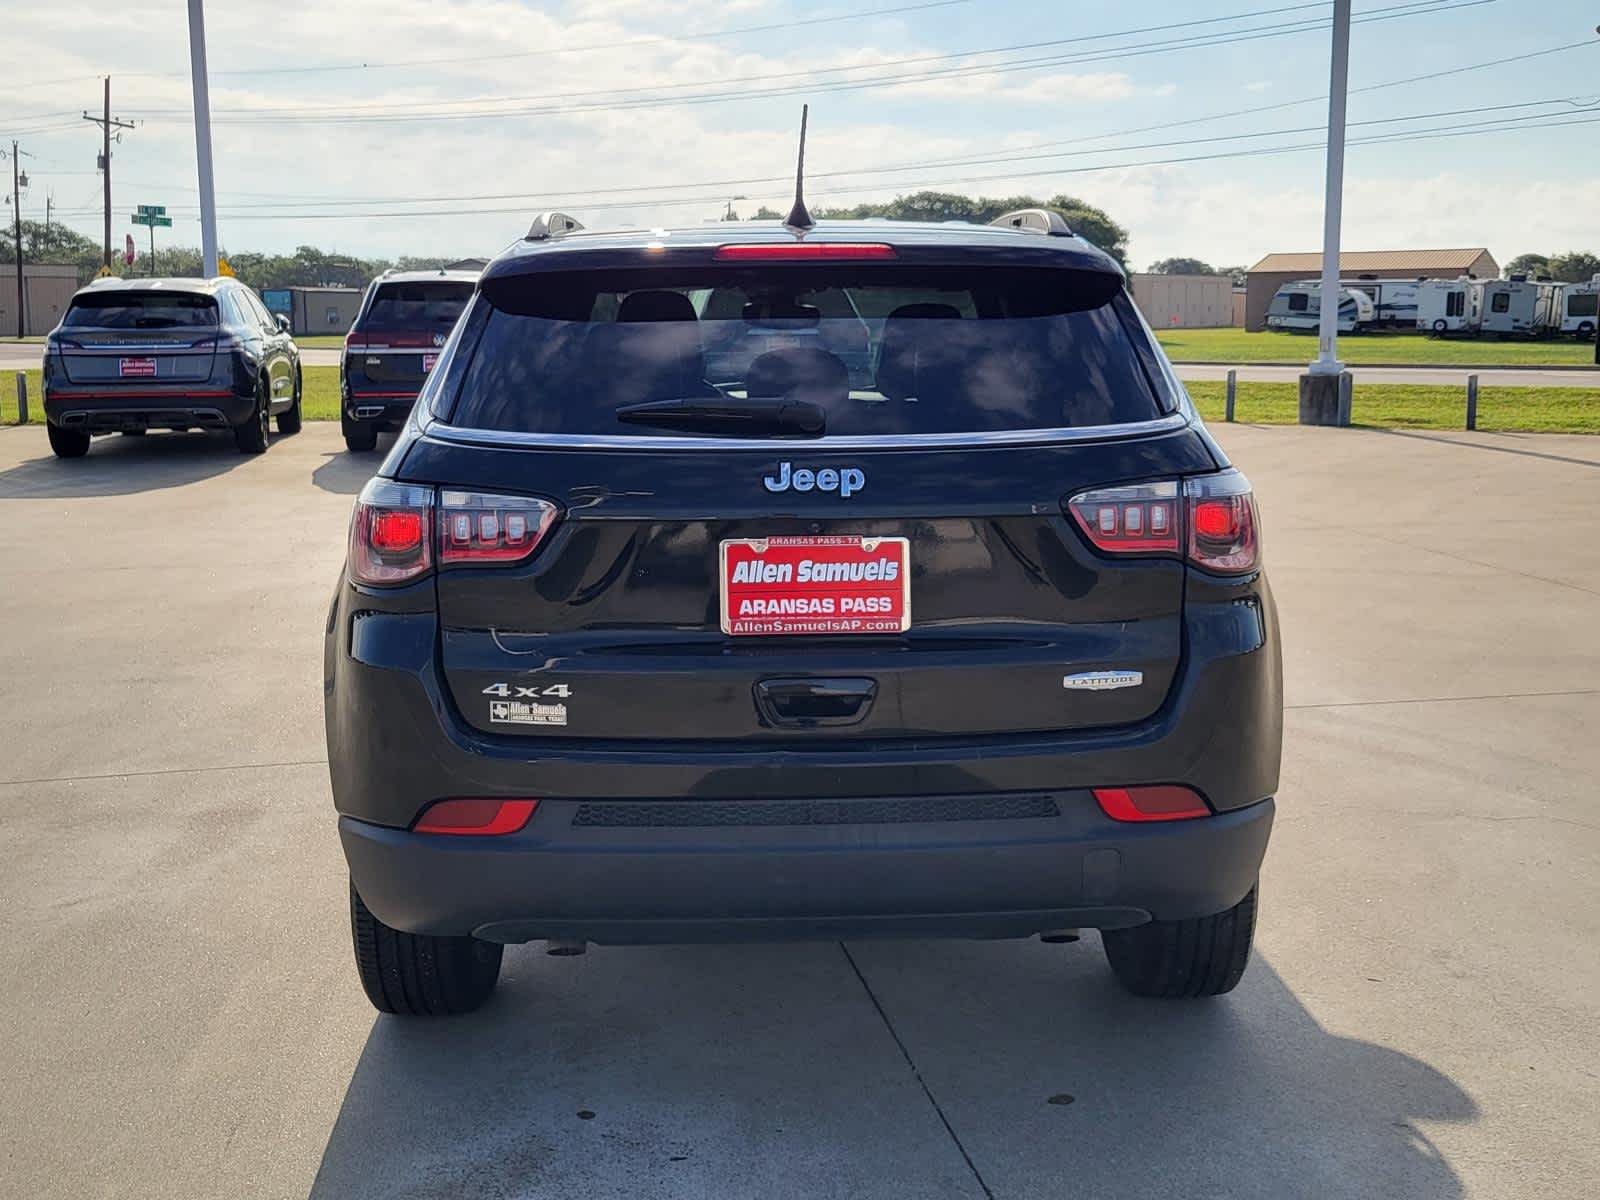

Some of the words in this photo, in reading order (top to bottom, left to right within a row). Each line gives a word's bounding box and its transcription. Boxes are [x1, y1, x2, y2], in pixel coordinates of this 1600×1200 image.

[764, 462, 865, 497] Jeep
[769, 537, 815, 545] ARANSAS
[732, 560, 793, 583] Allen
[796, 558, 899, 582] Samuels
[739, 599, 835, 615] ARANSAS
[840, 597, 893, 613] PASS
[733, 620, 899, 633] AllenSamuelsAP.com
[1071, 676, 1138, 685] LATITUDE
[482, 683, 573, 698] 4x4
[510, 701, 531, 714] Allen
[532, 702, 567, 716] Samuels
